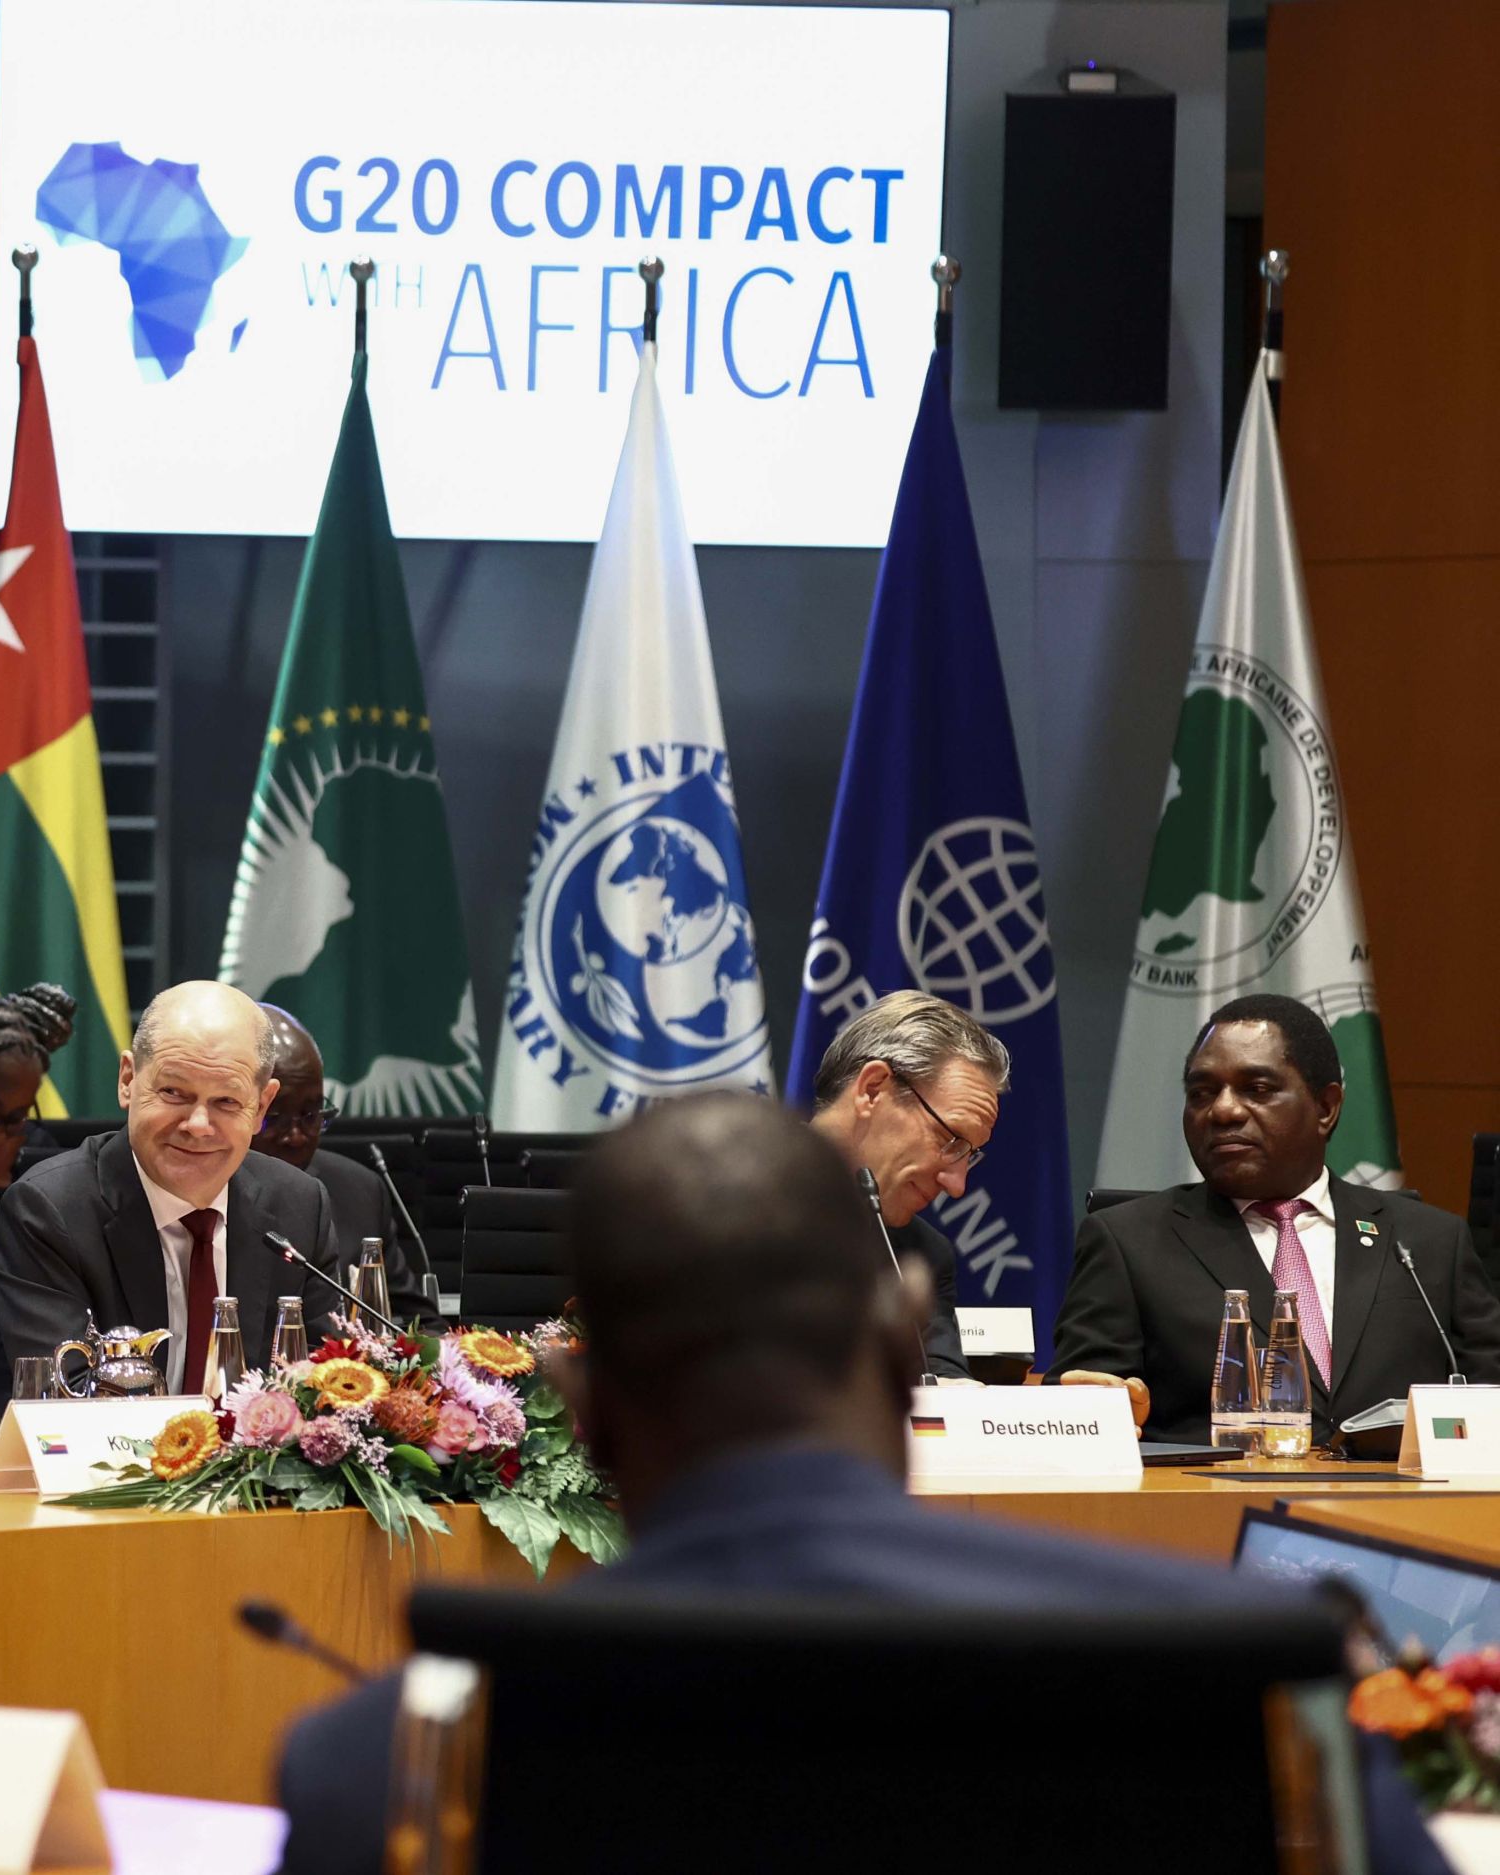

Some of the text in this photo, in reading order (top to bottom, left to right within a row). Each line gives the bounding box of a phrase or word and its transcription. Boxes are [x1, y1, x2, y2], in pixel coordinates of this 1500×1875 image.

[294, 155, 905, 245] G20 COMPACT
[302, 262, 874, 400] WTH AFRICA
[1299, 728, 1325, 761] DE
[1146, 964, 1198, 987] BANK
[960, 1327, 985, 1337] enia
[981, 1419, 1099, 1436] Deutschland
